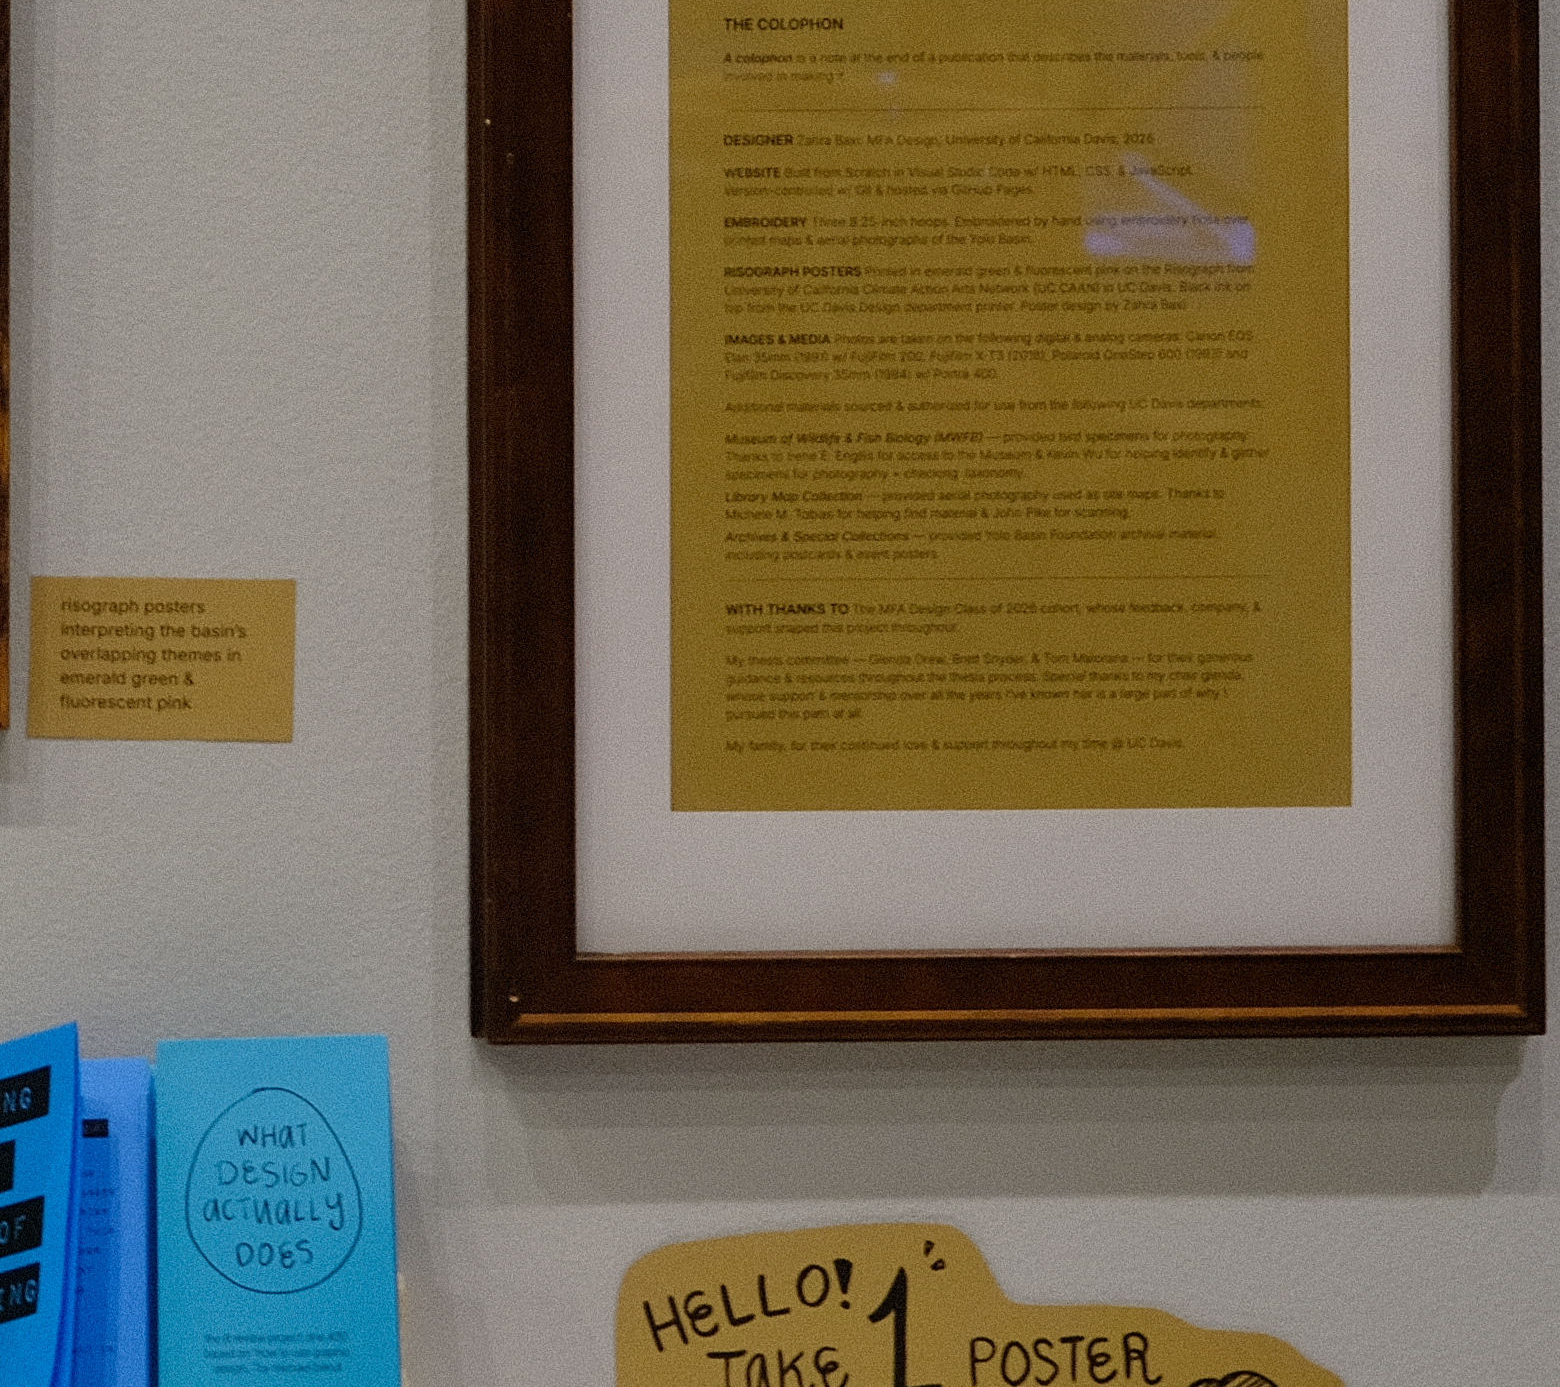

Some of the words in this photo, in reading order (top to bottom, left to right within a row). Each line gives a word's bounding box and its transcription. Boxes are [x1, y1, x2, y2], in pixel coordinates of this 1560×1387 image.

[723, 17, 756, 31] THE
[760, 17, 844, 32] COLOPHON
[723, 134, 793, 146] DESIGNER
[144, 600, 205, 615] posters
[767, 603, 824, 615] THANKS
[829, 603, 849, 615] TO
[160, 624, 185, 638] the
[161, 648, 222, 662] themes
[131, 673, 179, 688] green
[60, 695, 152, 709] fluorescent
[157, 695, 192, 712] pink
[217, 1157, 332, 1187] DESIGN
[643, 1259, 854, 1351] HELLO!
[970, 1332, 1161, 1387] POSTER
